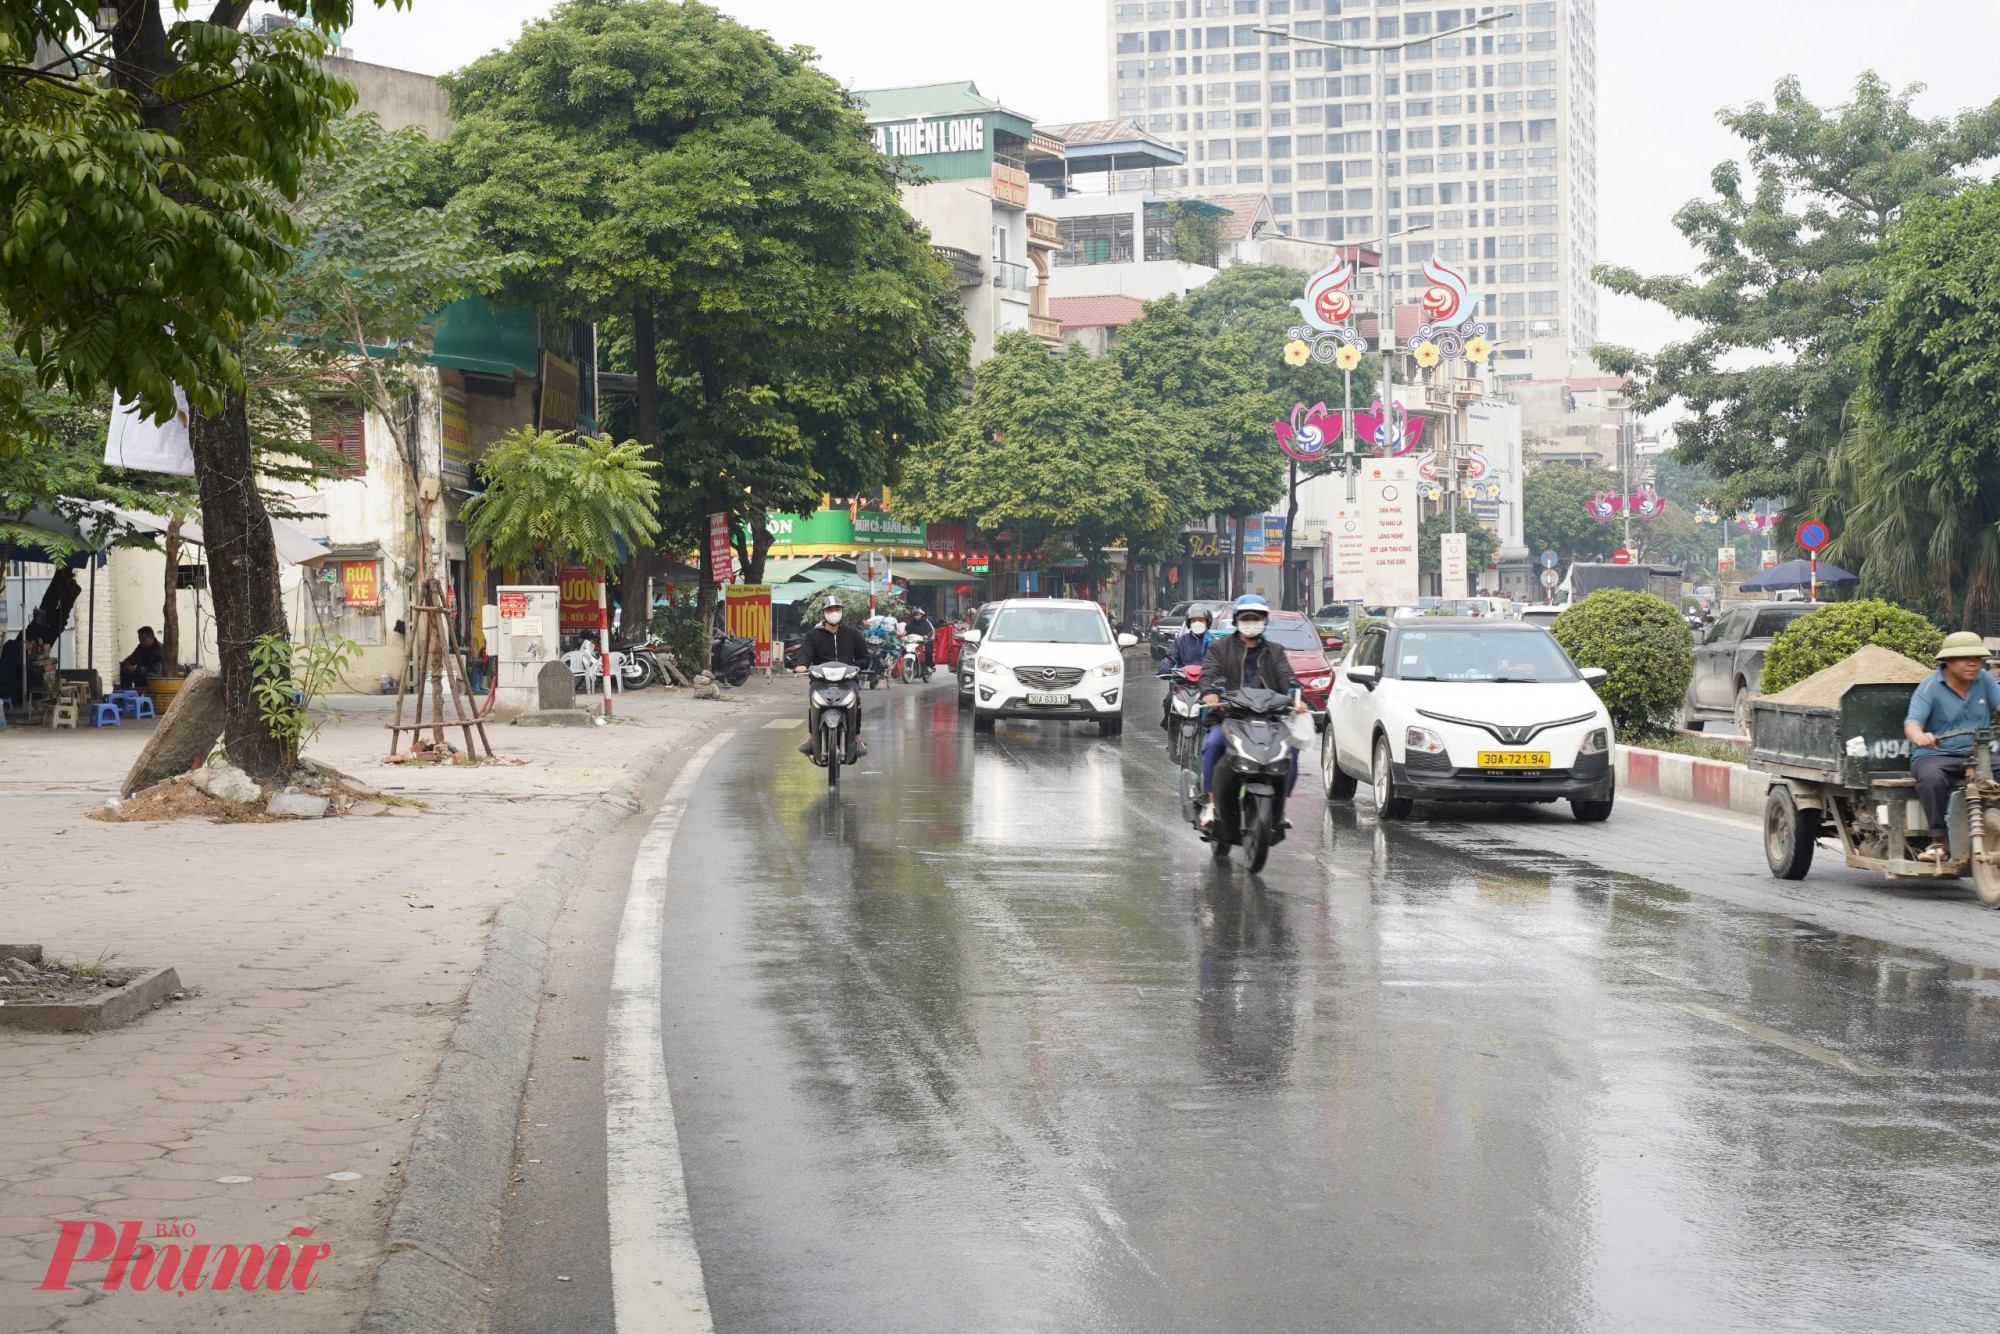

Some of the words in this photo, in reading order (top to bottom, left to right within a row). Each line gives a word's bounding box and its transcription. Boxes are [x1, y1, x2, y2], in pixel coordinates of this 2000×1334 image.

[889, 118, 938, 156] THIÊN
[939, 118, 984, 153] LONG
[928, 539, 955, 551] viettel
[352, 584, 369, 600] XE
